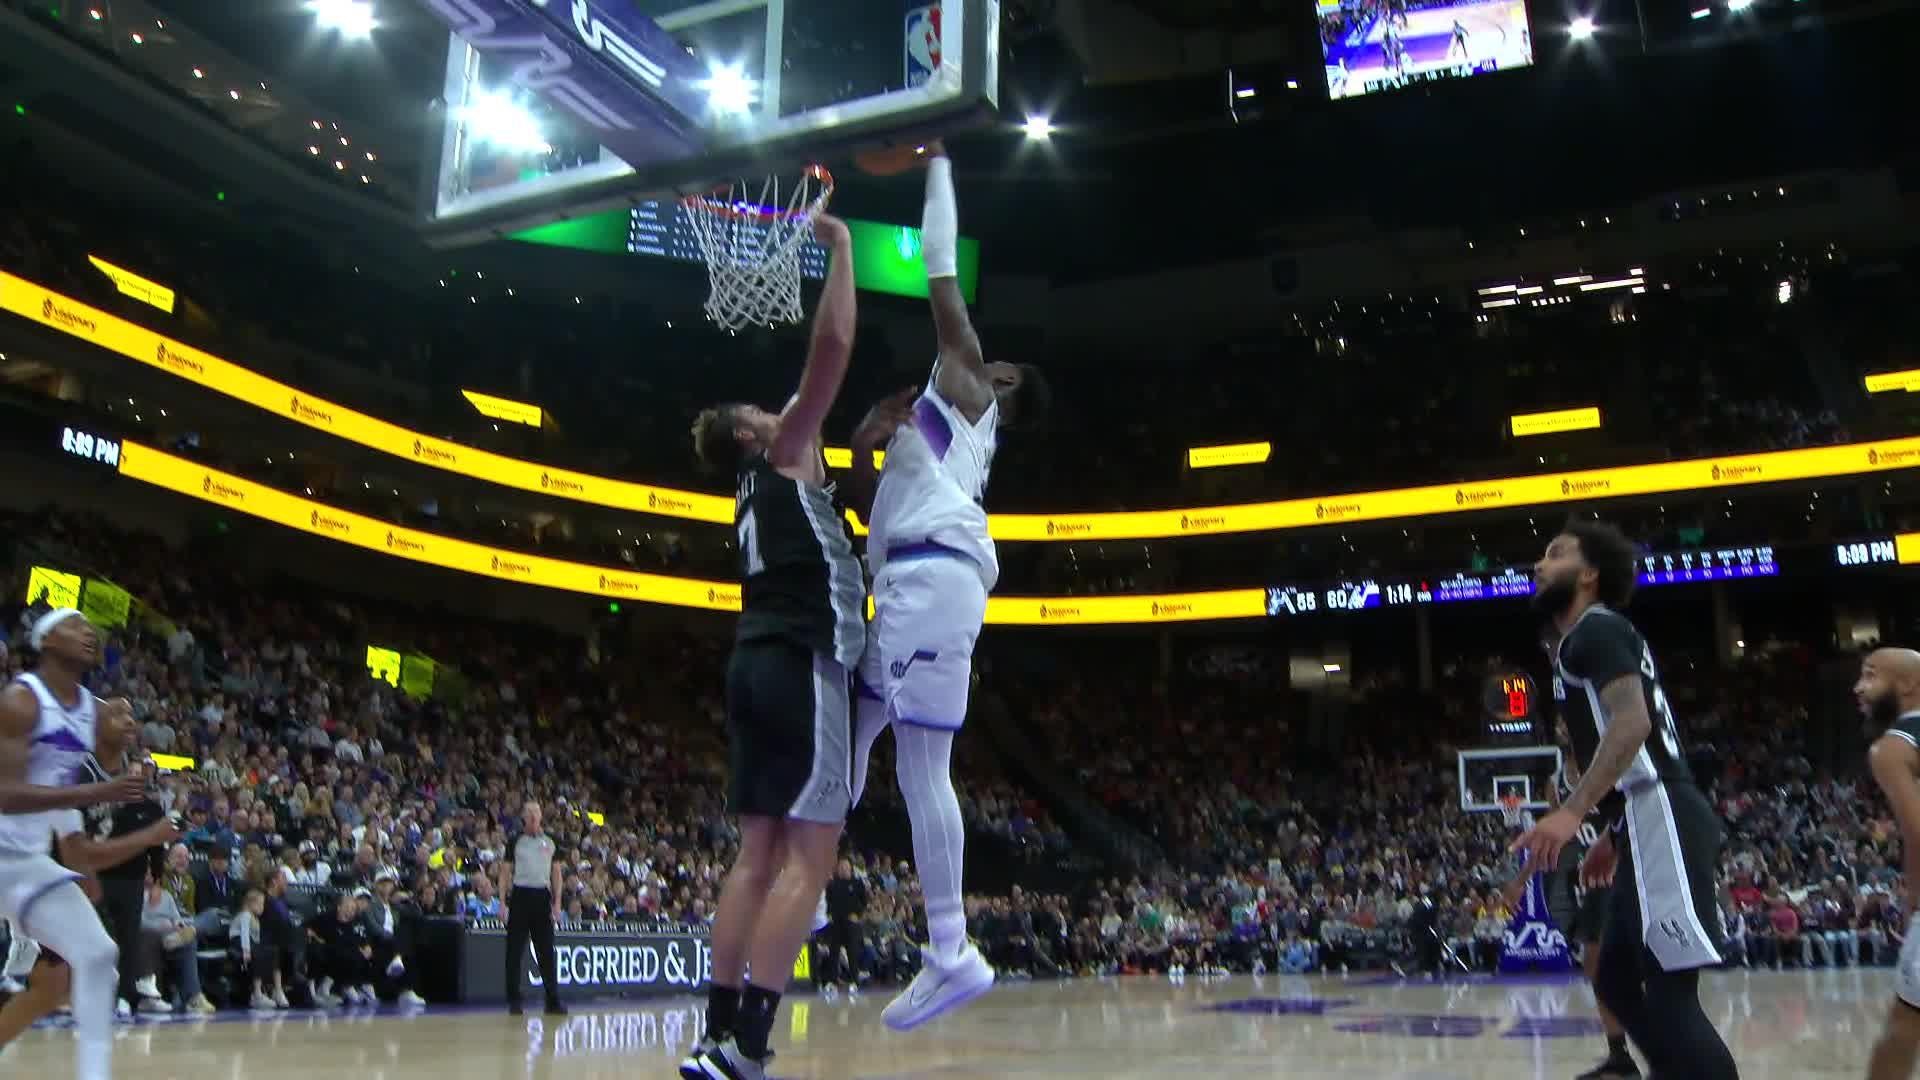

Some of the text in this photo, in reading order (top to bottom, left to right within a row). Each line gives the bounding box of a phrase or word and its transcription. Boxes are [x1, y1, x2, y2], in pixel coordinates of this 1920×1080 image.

[95, 437, 119, 467] PM
[1871, 541, 1896, 563] PM
[528, 940, 659, 986] SEGFRIED
[663, 941, 690, 983] &
